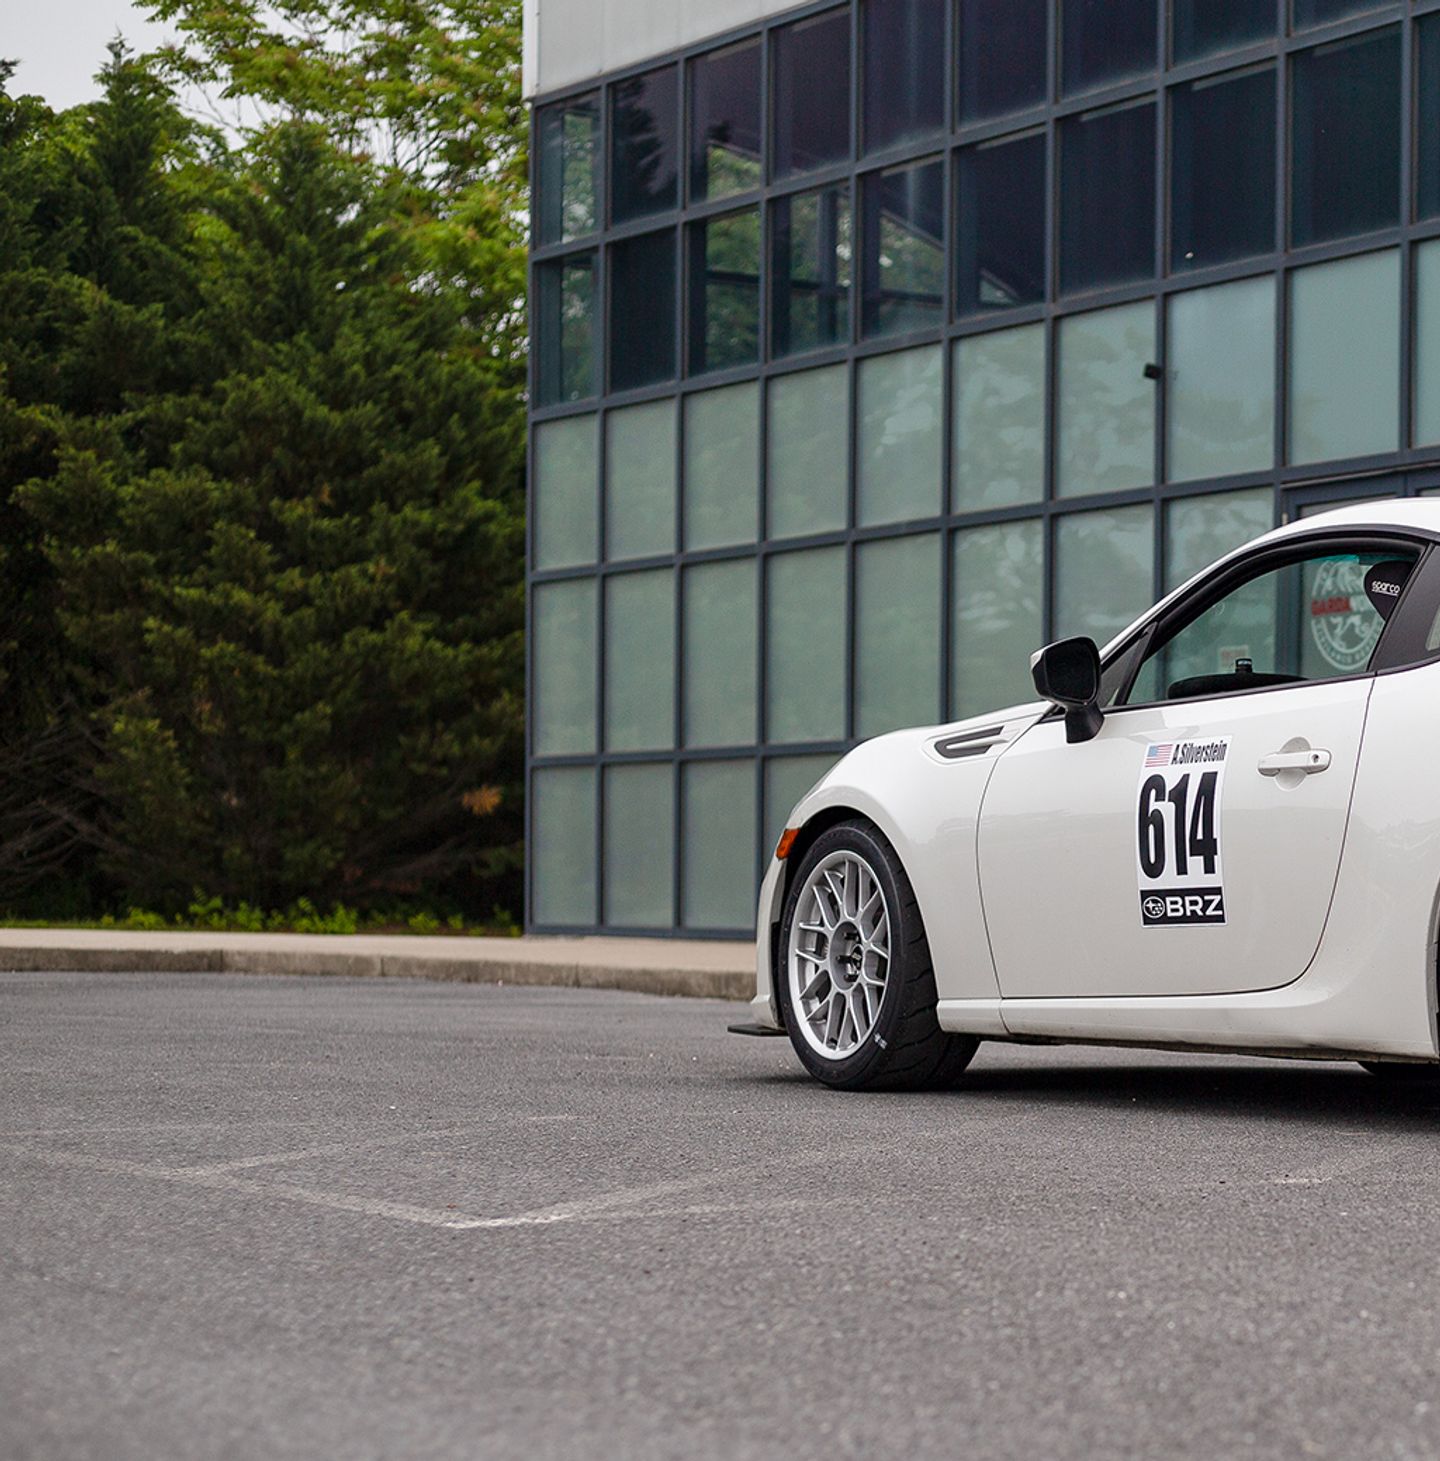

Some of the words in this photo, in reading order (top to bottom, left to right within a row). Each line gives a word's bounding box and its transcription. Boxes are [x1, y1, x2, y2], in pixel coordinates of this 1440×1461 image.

[1171, 740, 1227, 765] A.Silverstein
[1138, 771, 1218, 879] 614
[1166, 895, 1223, 917] BRZ
